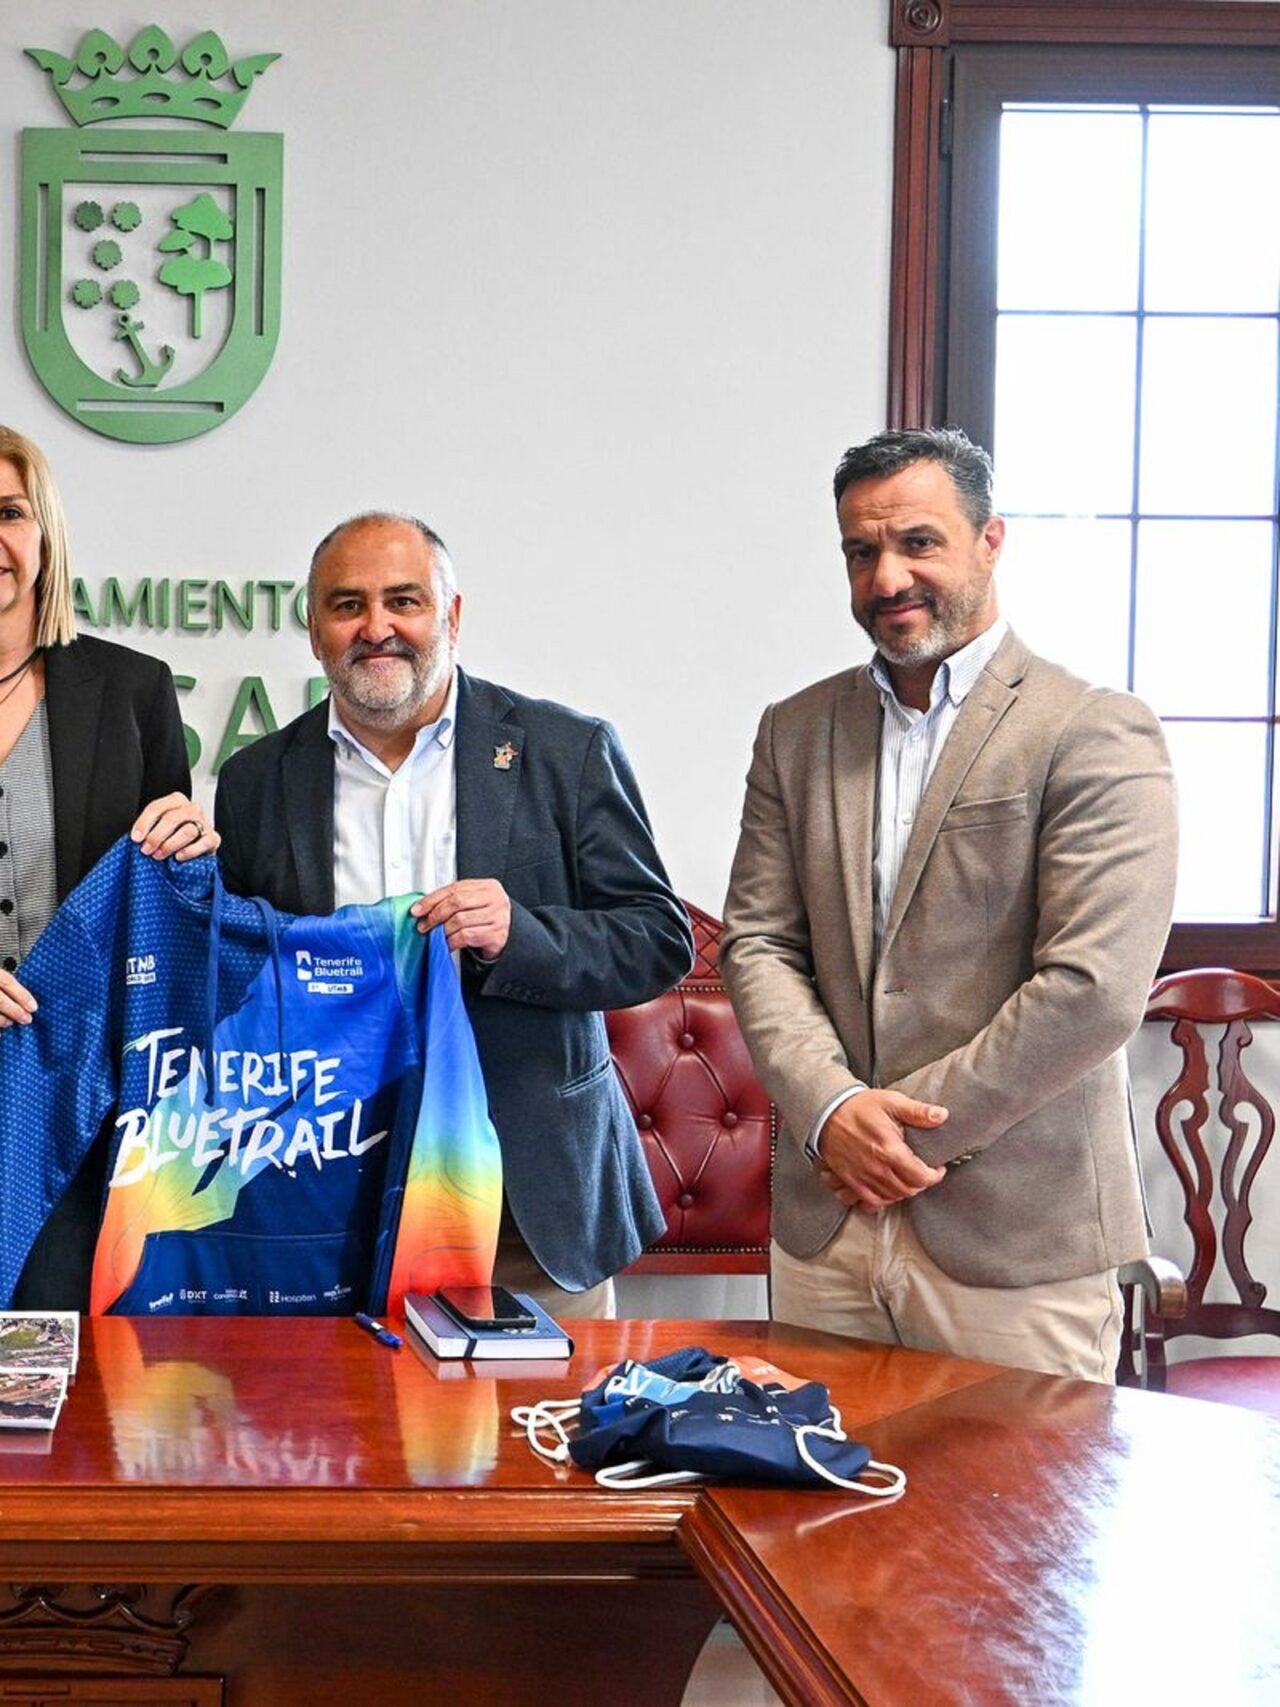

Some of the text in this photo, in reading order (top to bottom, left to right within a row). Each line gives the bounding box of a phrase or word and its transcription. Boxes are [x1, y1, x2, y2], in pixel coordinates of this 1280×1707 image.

[313, 956, 362, 967] Tenerife
[314, 967, 364, 977] Bluetrail
[124, 1027, 348, 1106] TENERIFE
[109, 1099, 388, 1187] BLUETRAIL
[187, 1290, 208, 1300] DXT
